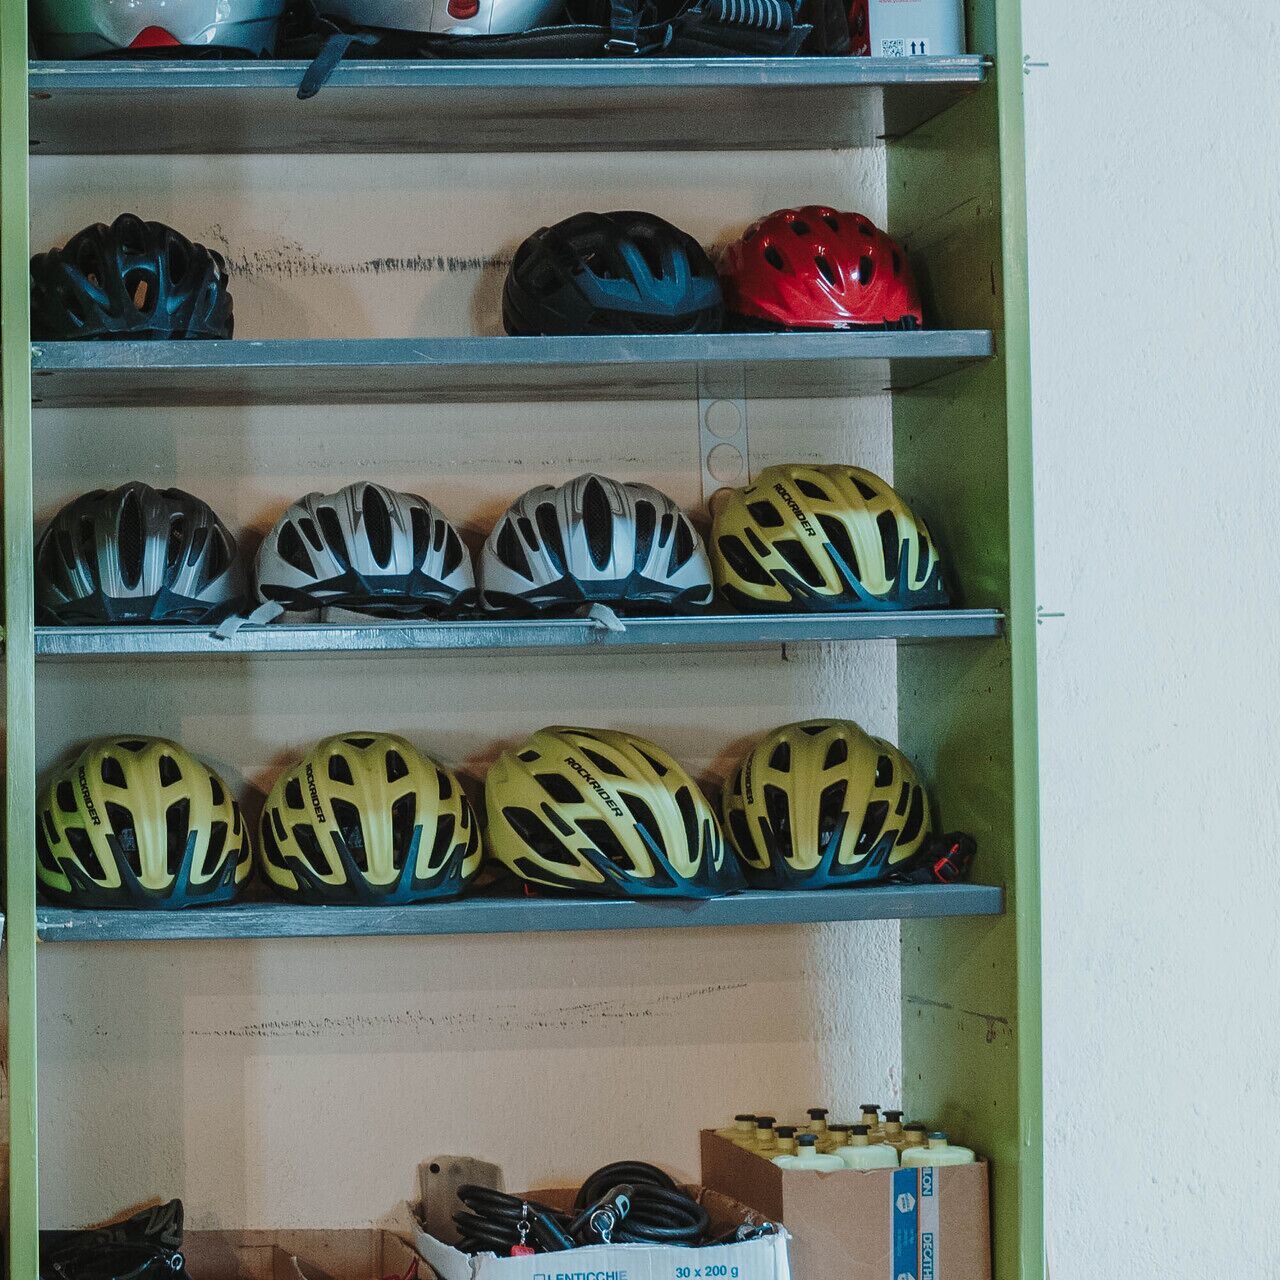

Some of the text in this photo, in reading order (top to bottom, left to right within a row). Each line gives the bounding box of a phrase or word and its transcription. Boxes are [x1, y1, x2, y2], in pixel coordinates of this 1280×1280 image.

[773, 483, 816, 537] ROCKRIDER
[306, 762, 326, 823] ROCKRIDER
[563, 756, 624, 817] ROCKRIDER
[676, 1267, 691, 1278] 30
[695, 1269, 701, 1277] x
[705, 1265, 727, 1277] 200
[731, 1266, 739, 1278] g
